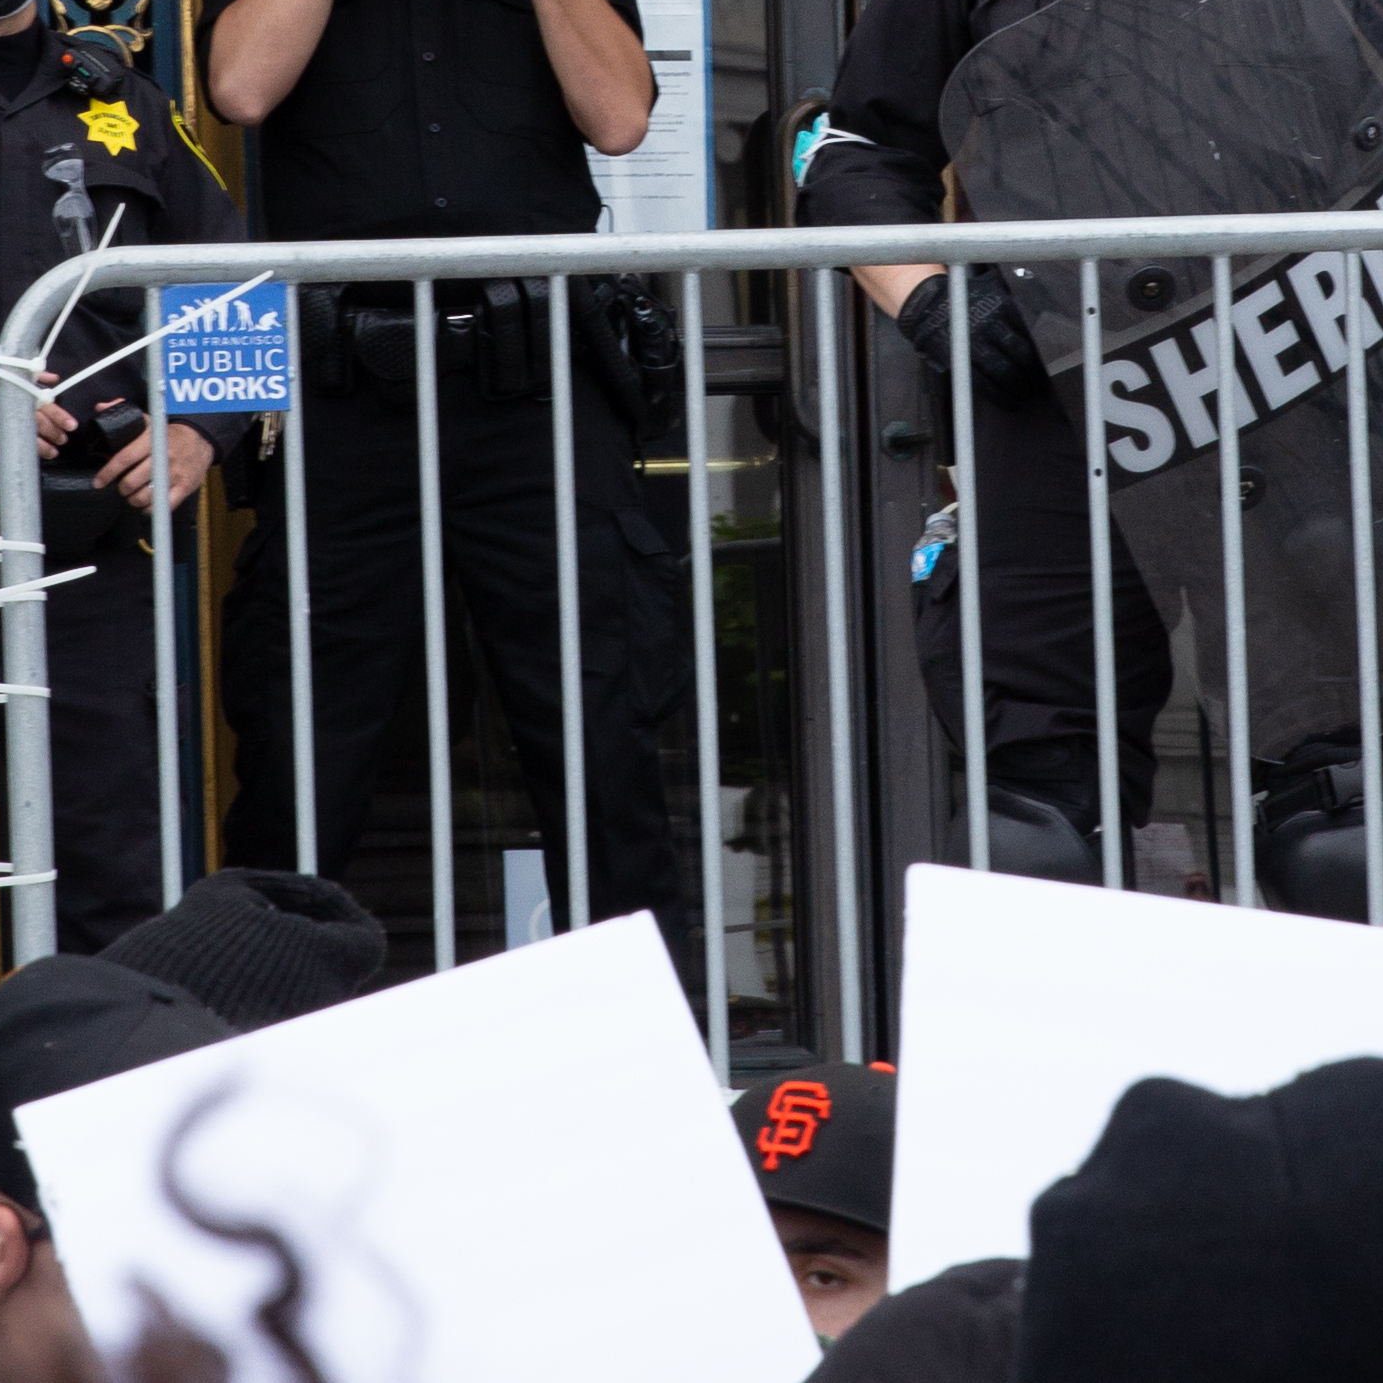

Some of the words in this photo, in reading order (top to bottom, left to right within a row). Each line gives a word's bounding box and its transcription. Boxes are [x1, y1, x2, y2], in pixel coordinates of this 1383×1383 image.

[167, 337, 198, 349] SAN
[201, 333, 285, 347] FRANCISCO
[167, 347, 286, 375] PUBLIC
[168, 373, 288, 403] WORKS
[756, 1080, 833, 1171] SF
